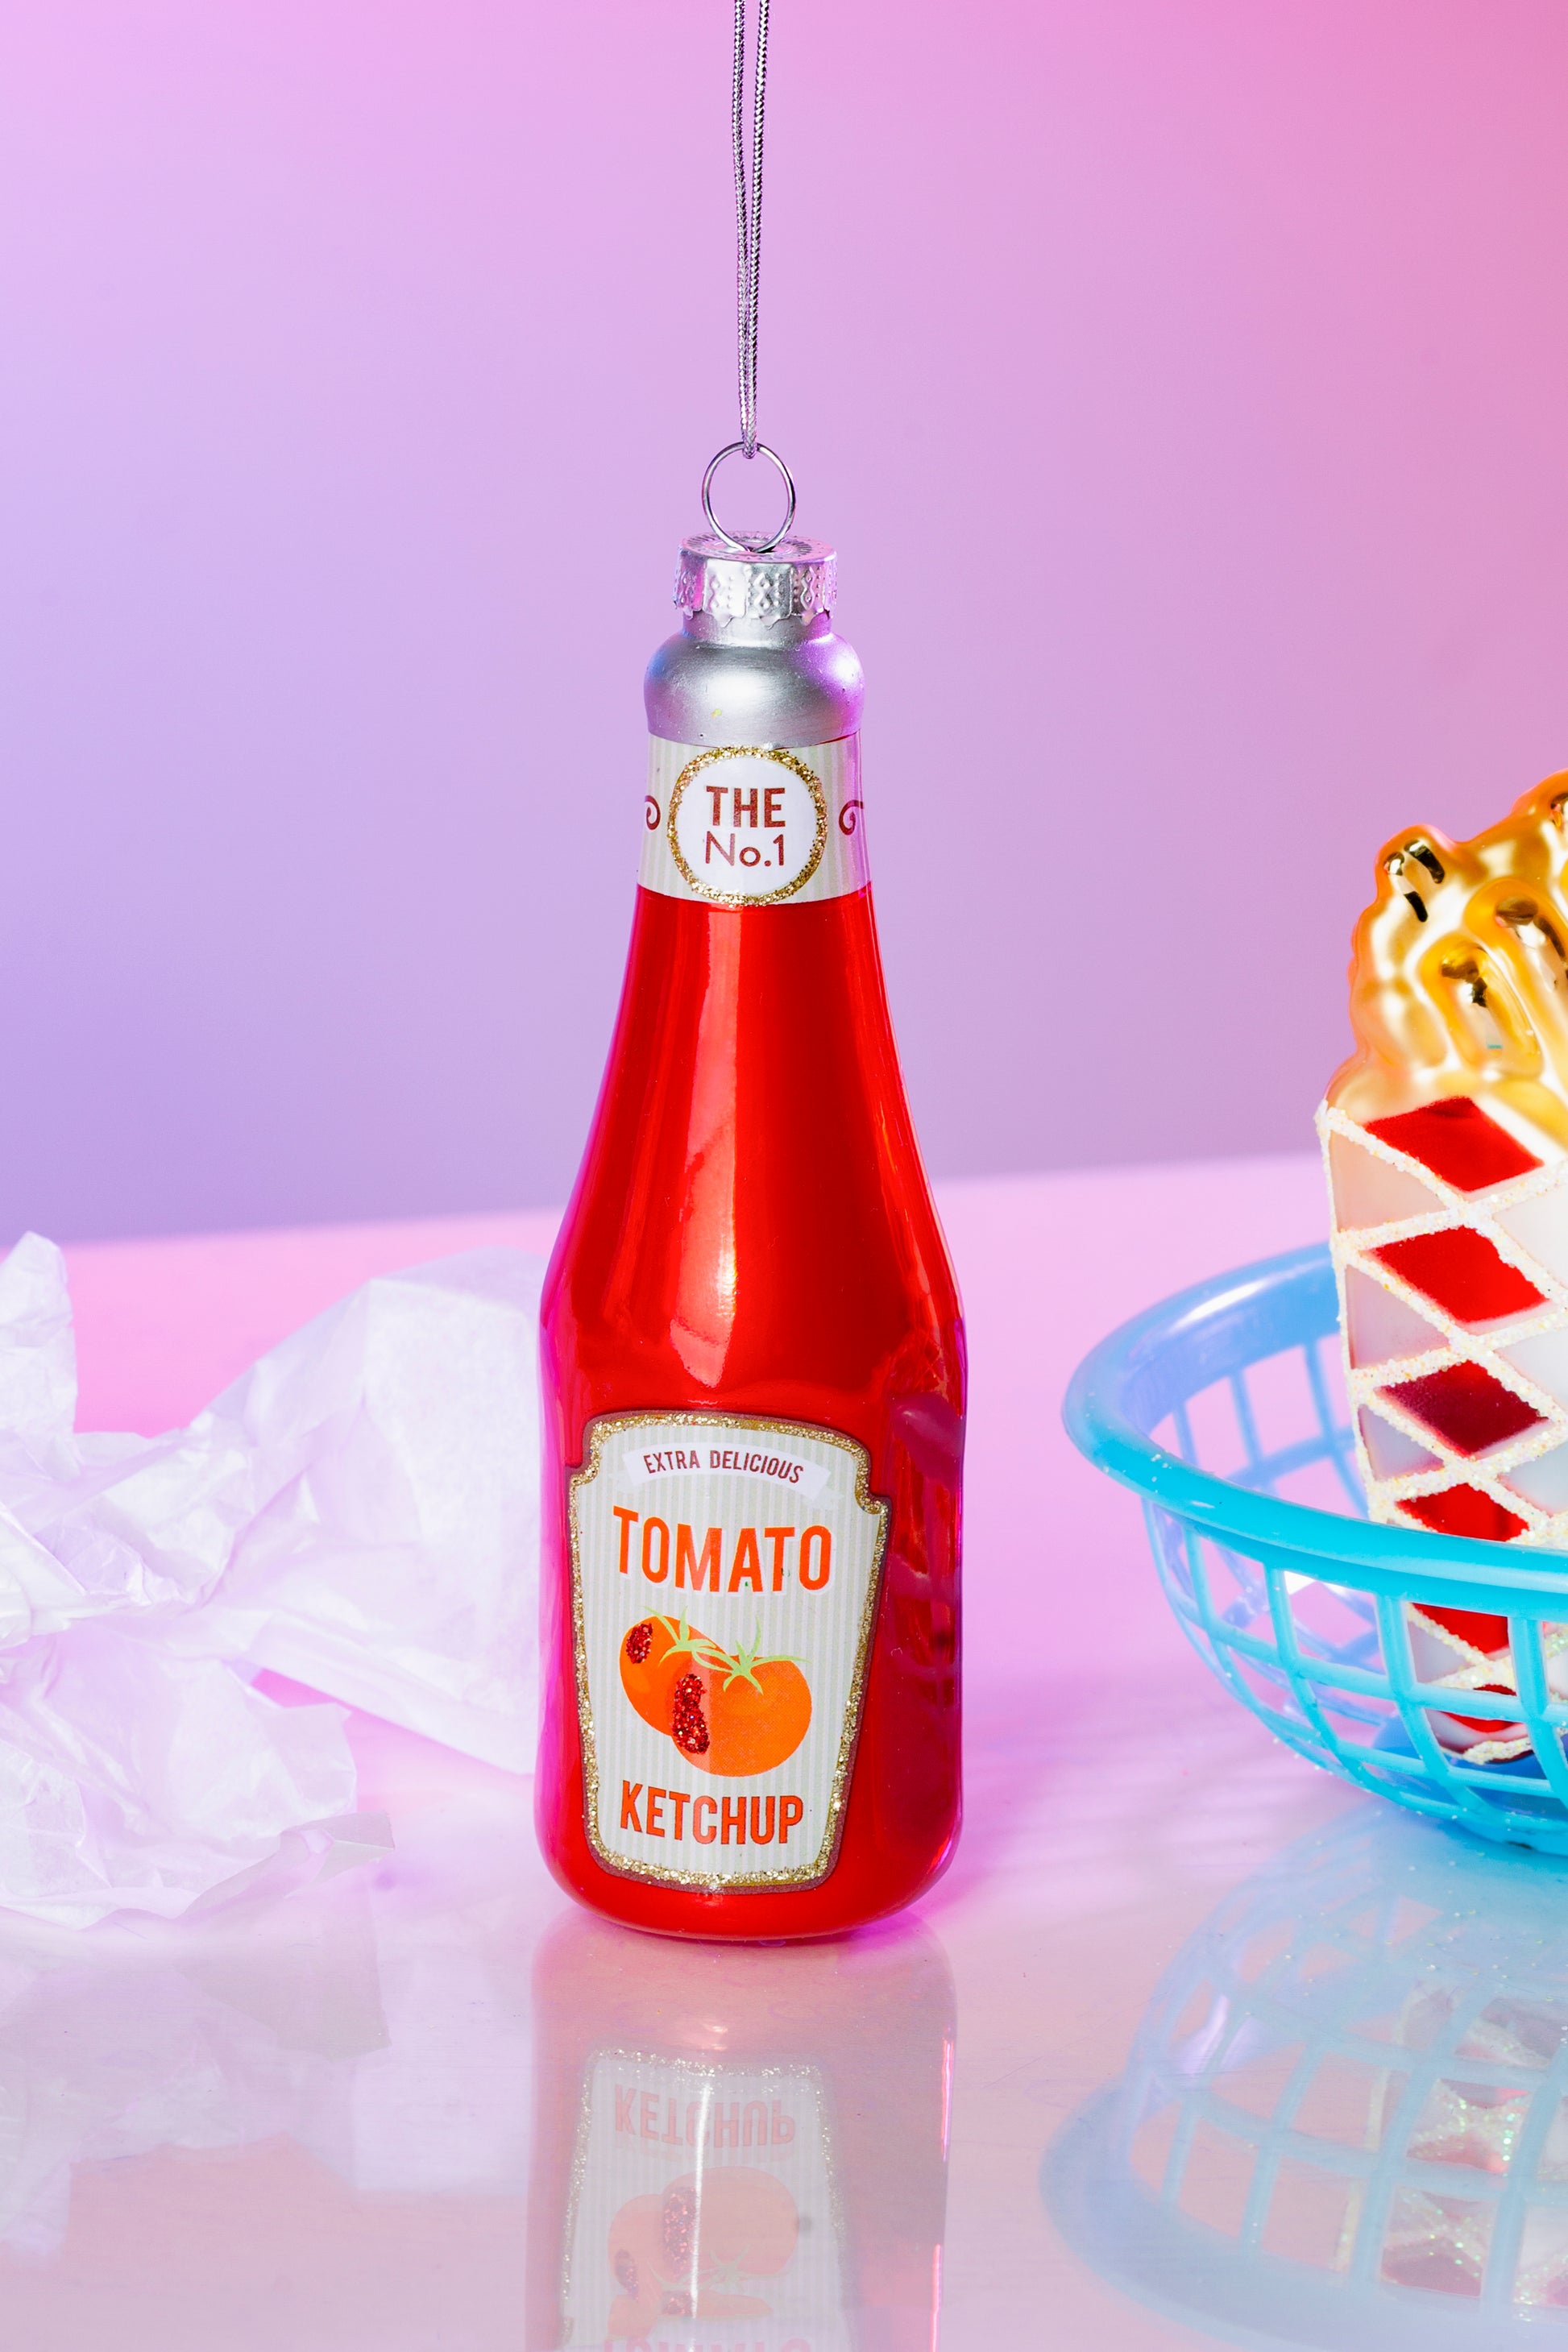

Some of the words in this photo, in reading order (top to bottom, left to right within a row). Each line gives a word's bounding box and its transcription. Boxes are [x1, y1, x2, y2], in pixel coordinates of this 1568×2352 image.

[706, 786, 786, 828] THE
[705, 831, 785, 867] No.1
[643, 1450, 701, 1474] EXTRA
[710, 1450, 804, 1483] DELICIOUS
[613, 1504, 832, 1593] TOMATO
[620, 1779, 804, 1845] KETCHUP
